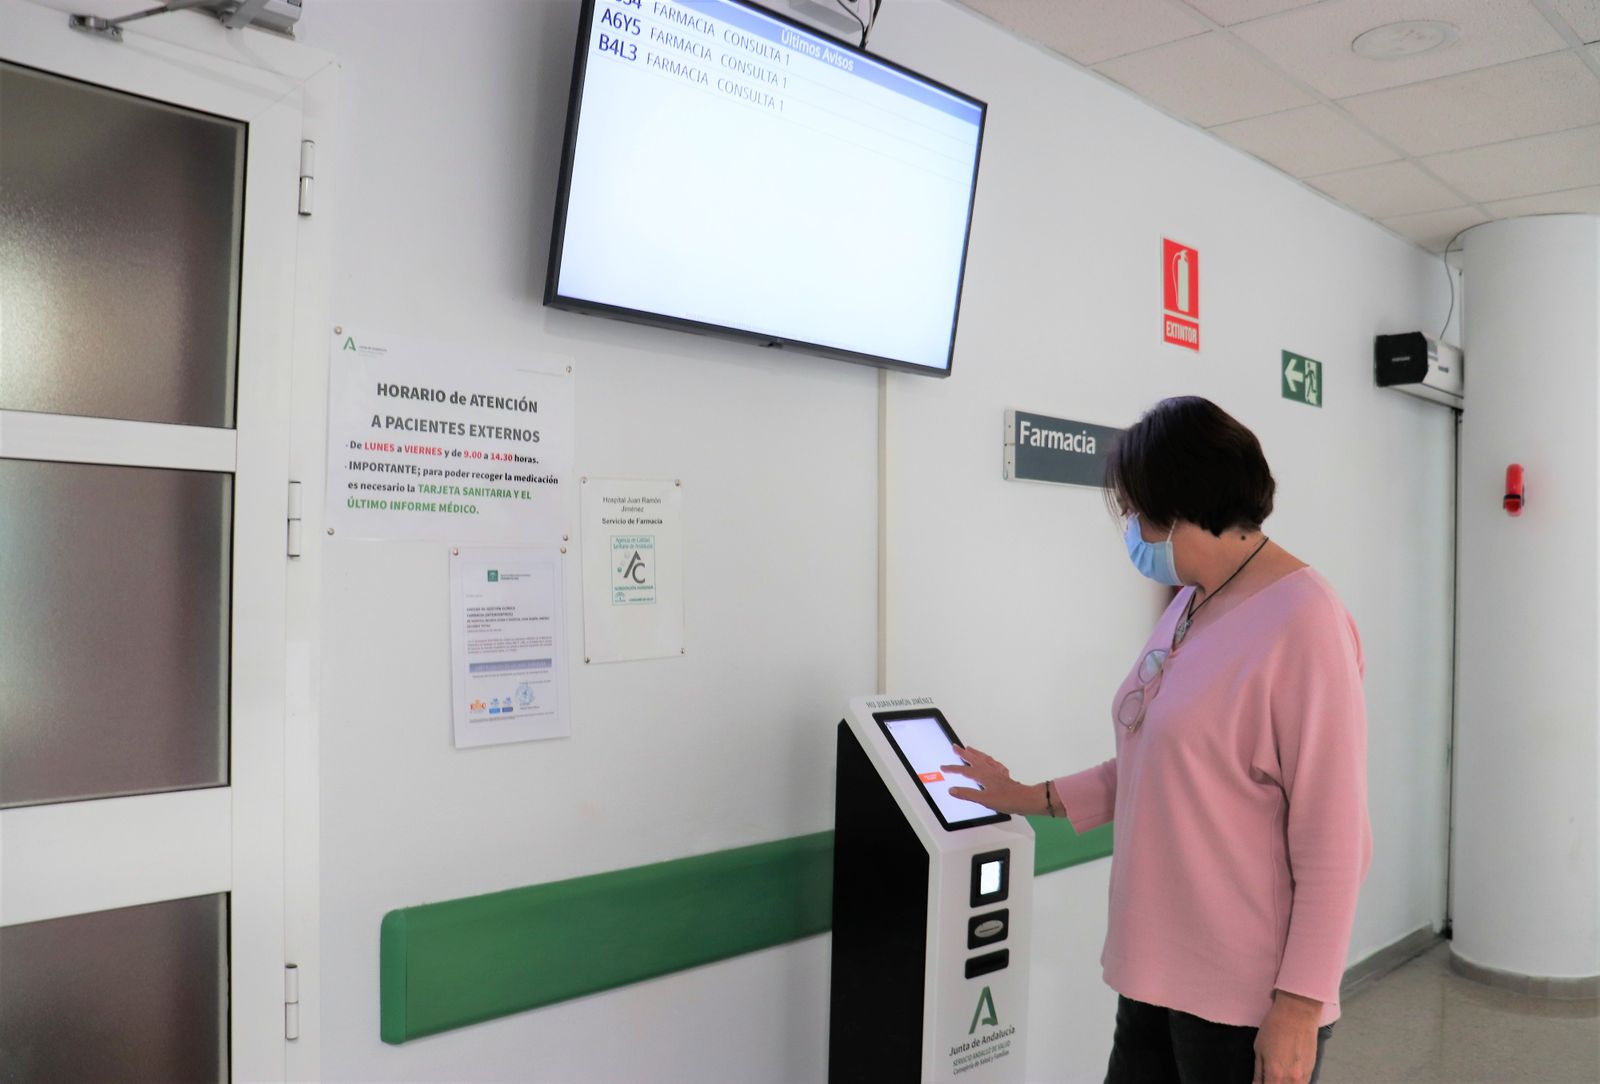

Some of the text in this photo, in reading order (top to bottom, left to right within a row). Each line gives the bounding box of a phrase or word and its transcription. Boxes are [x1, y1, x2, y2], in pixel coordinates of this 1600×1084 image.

[601, 8, 788, 89] A6Y5 FARMACIA CONSULTA 1
[652, 1, 790, 66] FARMACIA CONSULTA 1
[781, 27, 854, 72] Últimos Avisos
[599, 33, 785, 112] B4L3 FARMACIA CONSULTA 1
[1166, 322, 1196, 344] EXTINTOR
[377, 382, 538, 413] HORARIO de ATENCIÓN
[371, 414, 541, 444] A PACIENTES EXTERNOS
[1020, 420, 1097, 455] Farmacia
[350, 440, 362, 450] De
[364, 441, 395, 452] LUNES
[404, 444, 443, 456] VIERNES
[444, 449, 450, 458] y
[451, 447, 462, 458] de
[464, 450, 482, 460] 9.00
[490, 452, 513, 462] 14.30
[514, 453, 539, 465] horas.
[349, 461, 558, 485] IMPORTANTE; para poder recoger la medicación
[347, 496, 480, 514] ÚLTIMO INFORME MÉDICO.
[348, 482, 532, 500] es necesario la TARJETA SANITARIA Y EL
[603, 496, 626, 504] Hospital
[949, 1025, 1015, 1056] Junta de Andalucía
